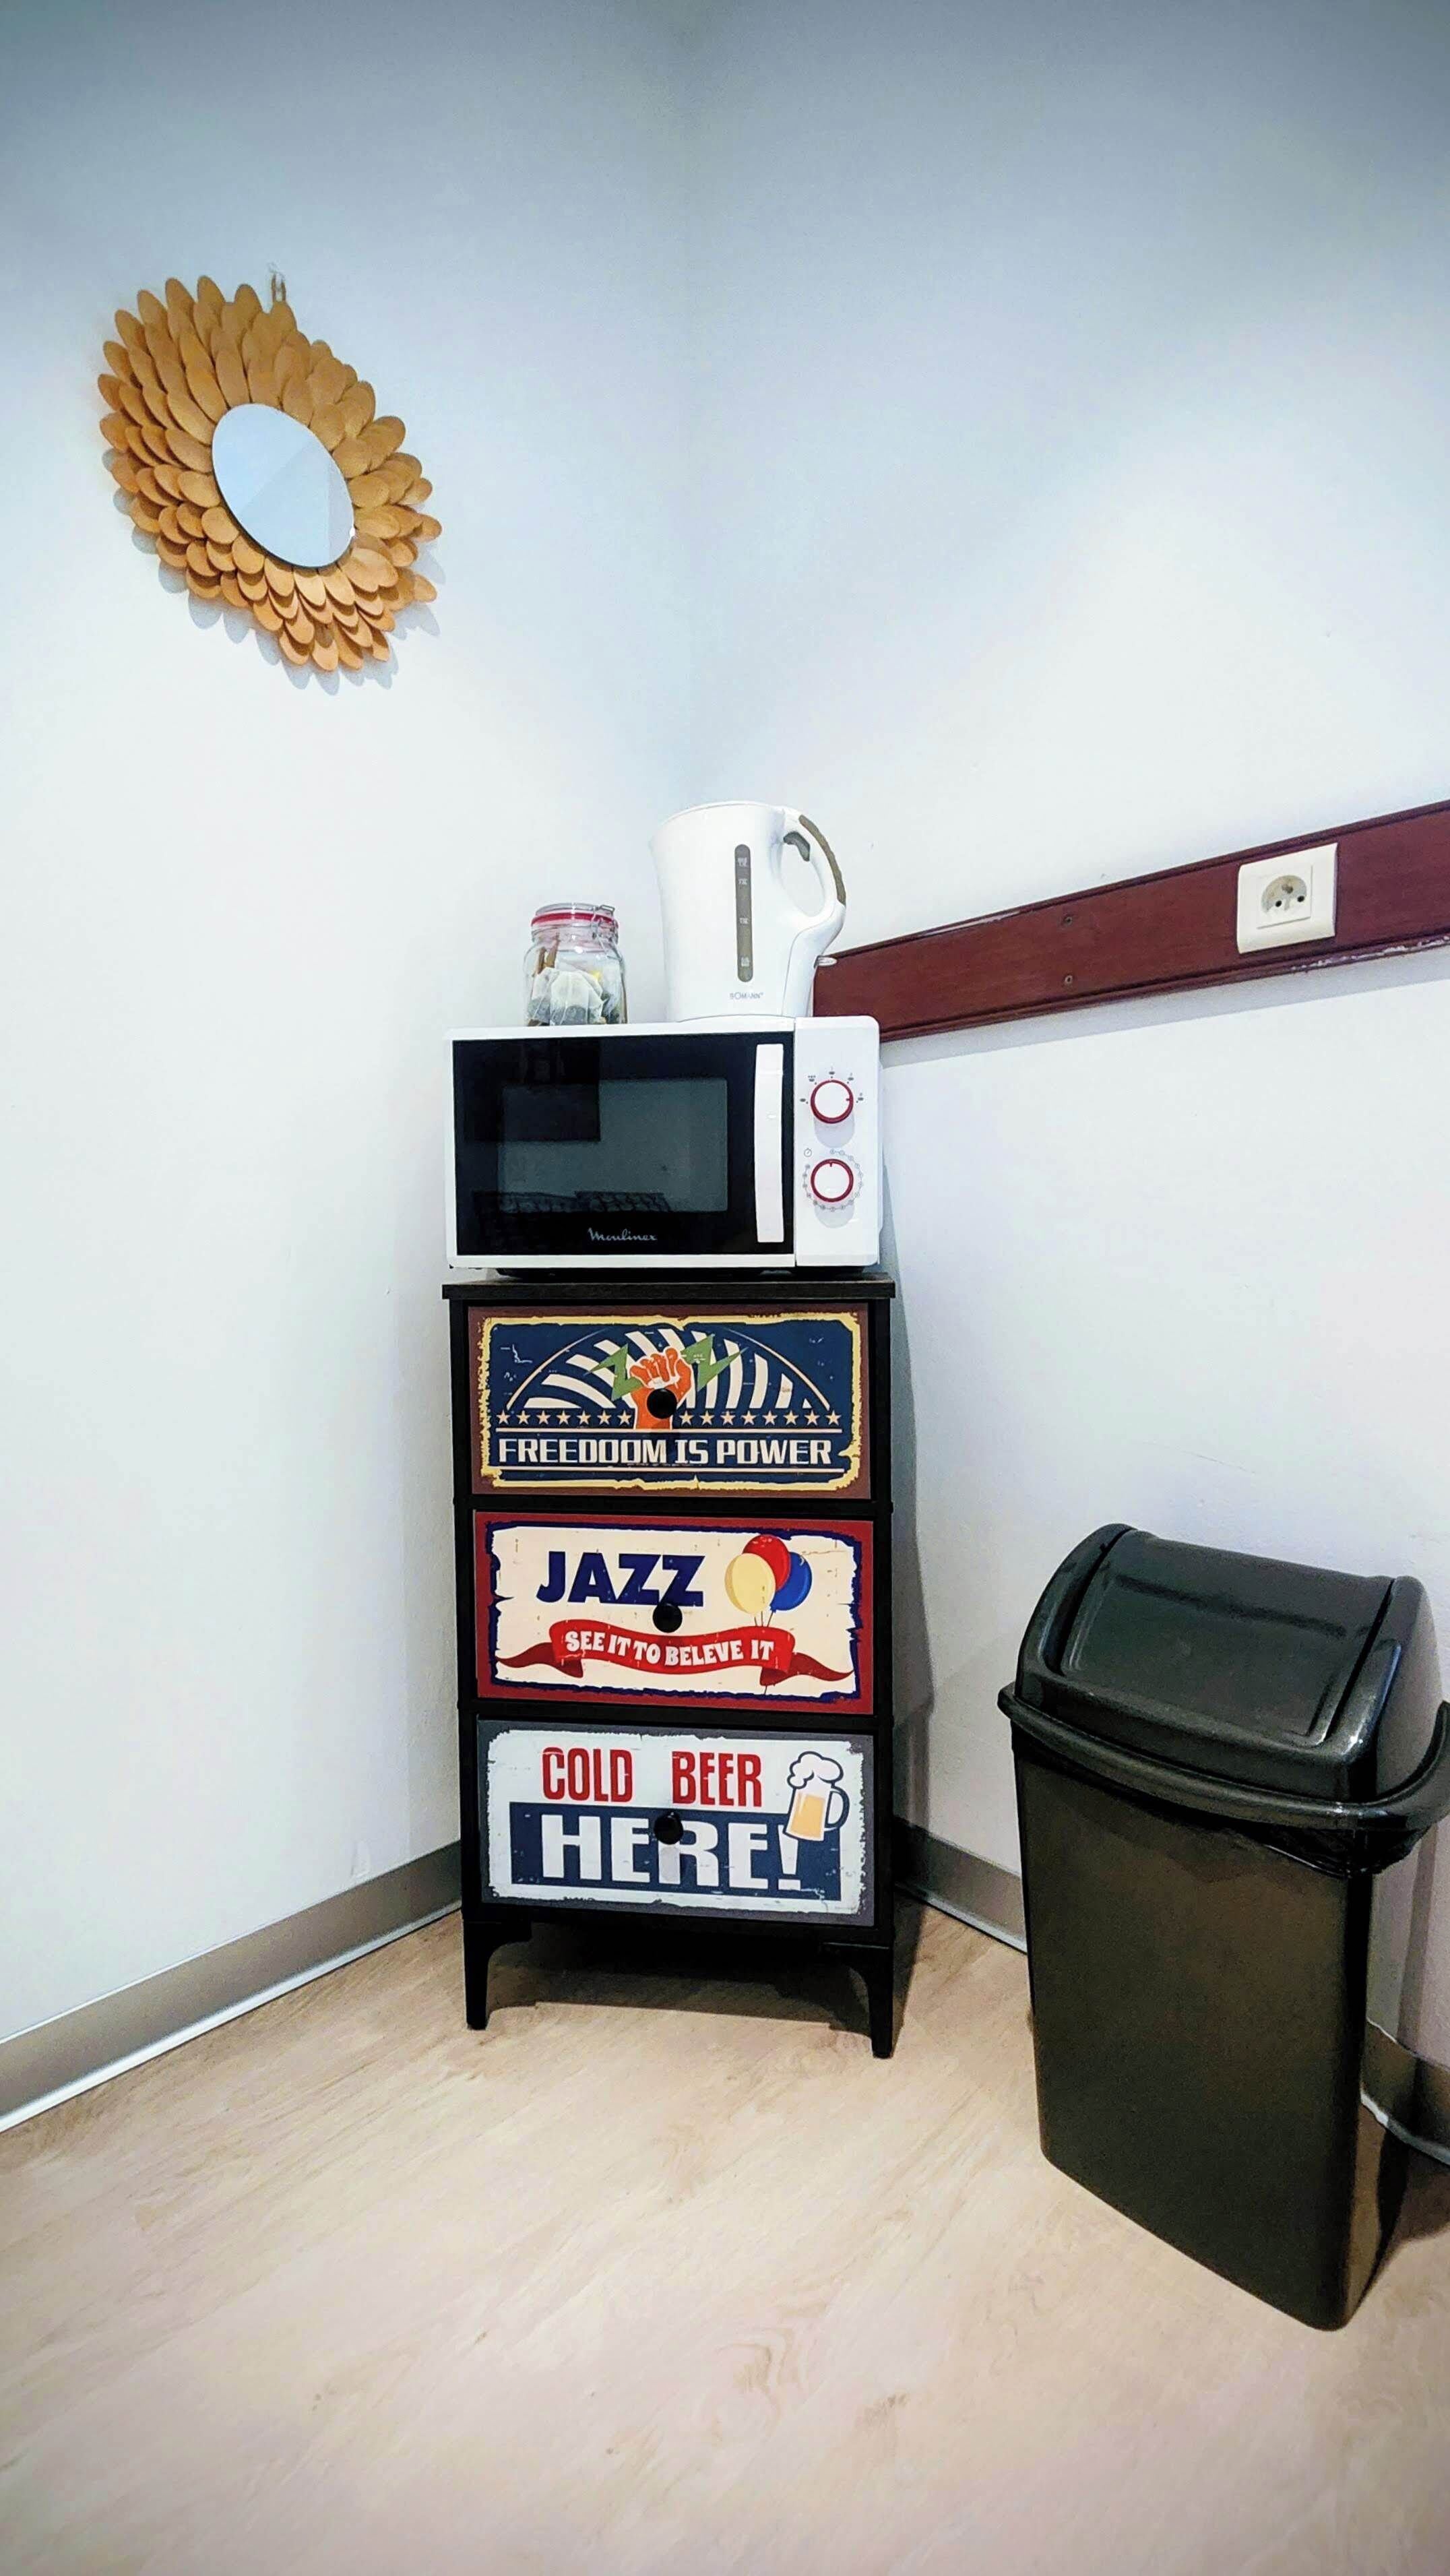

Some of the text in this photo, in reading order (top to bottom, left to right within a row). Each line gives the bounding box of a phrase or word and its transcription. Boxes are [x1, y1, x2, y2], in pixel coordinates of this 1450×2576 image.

[588, 1227, 658, 1241] Moulinex
[499, 1438, 832, 1465] FREEDOOM IS POWER
[536, 1551, 705, 1607] JAZZ
[565, 1631, 774, 1666] SEE IT TO BELEVE IT
[542, 1747, 762, 1807] COLD BEER
[541, 1814, 802, 1891] HERE!
